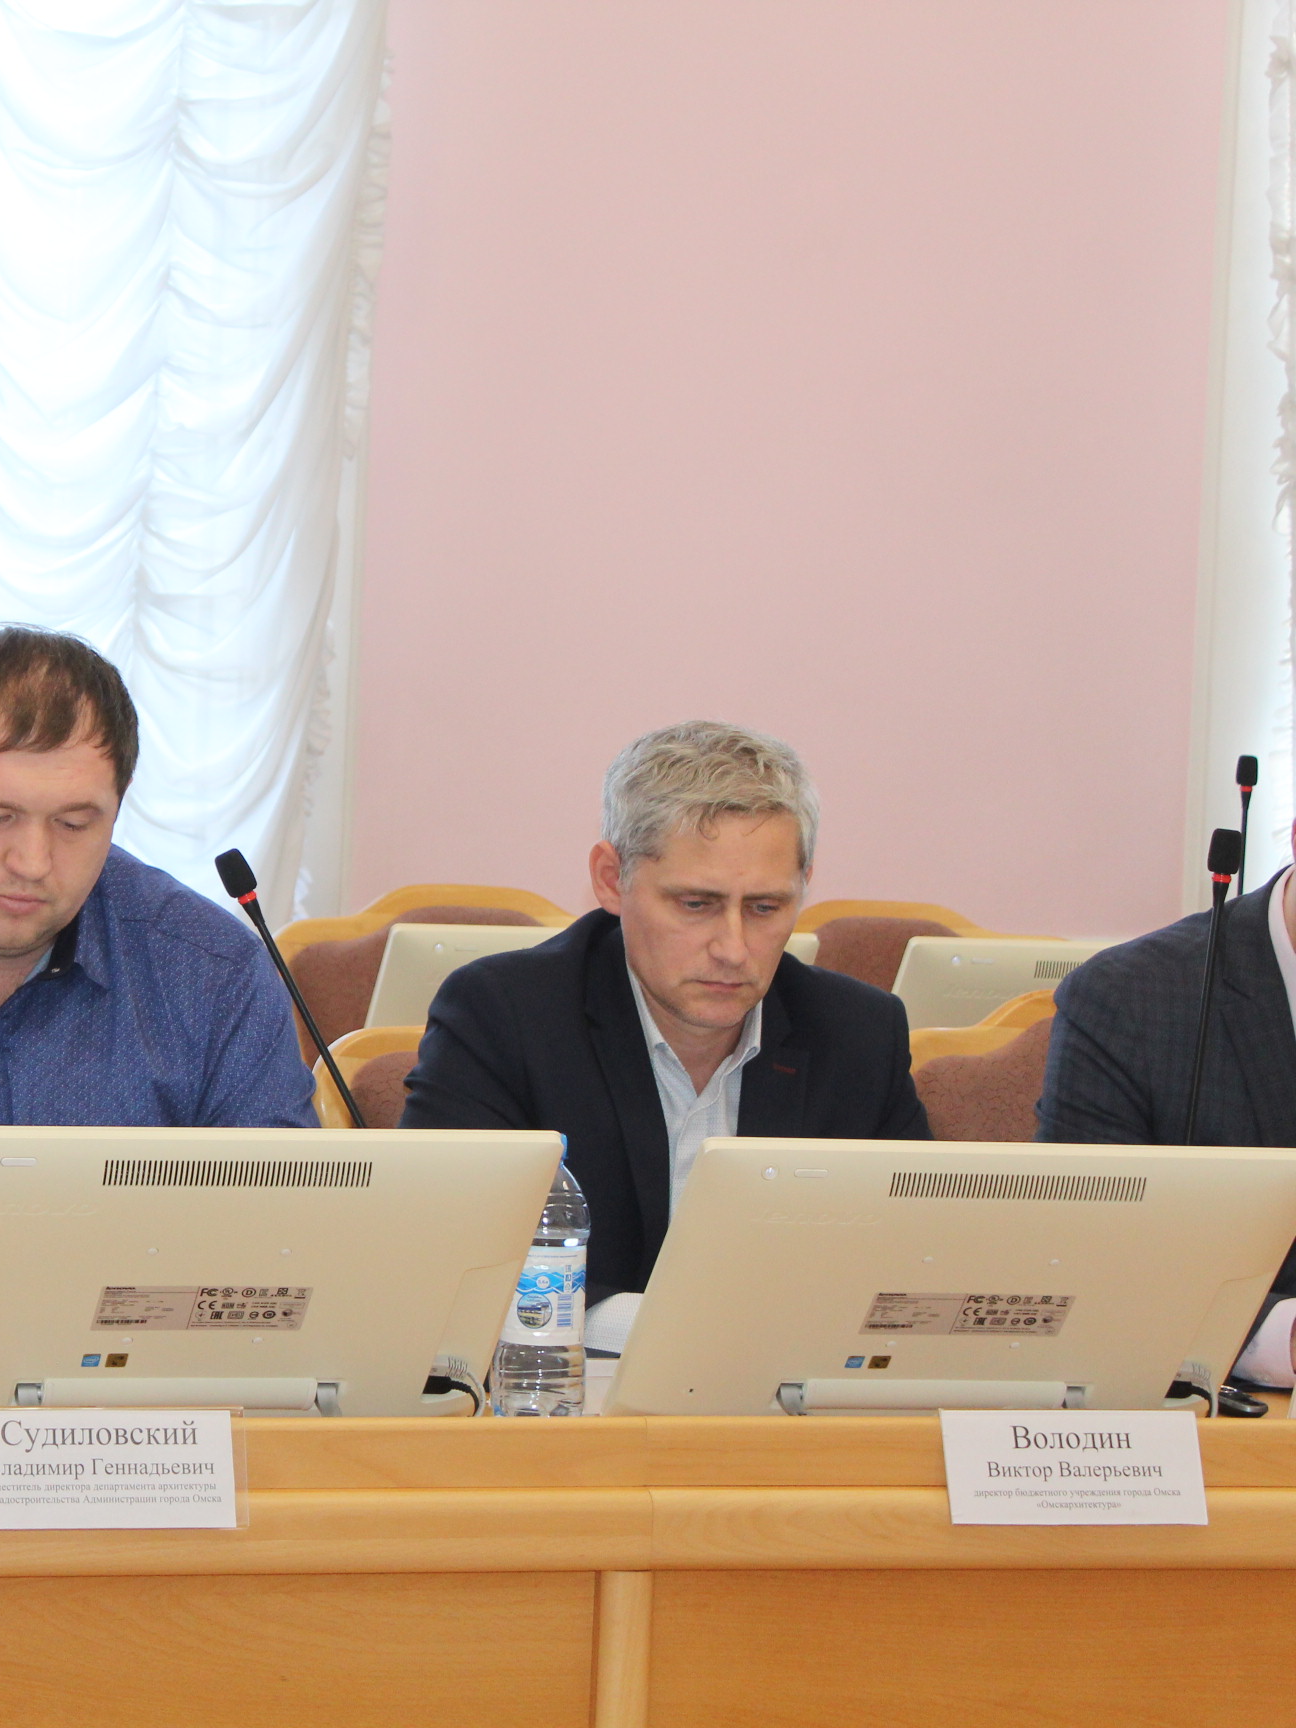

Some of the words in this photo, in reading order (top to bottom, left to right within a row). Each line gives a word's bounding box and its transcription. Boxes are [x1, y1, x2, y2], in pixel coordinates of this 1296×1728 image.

[1, 1420, 197, 1453] Судиловский
[1012, 1426, 1132, 1451] Володин
[92, 1459, 214, 1476] Геннадьевич
[987, 1462, 1052, 1482] Виктор
[1059, 1462, 1162, 1481] Валерьевич
[44, 1484, 90, 1493] директора
[94, 1484, 155, 1492] департамента
[158, 1483, 216, 1492] архитектуры
[974, 1490, 1013, 1498] директор
[1015, 1488, 1067, 1496] бюджетного
[1152, 1488, 1181, 1496] Омска
[83, 1495, 156, 1505] Администрации
[160, 1496, 190, 1504] города
[193, 1494, 222, 1502] Омска
[1037, 1500, 1121, 1509] «Омскархитектура»
